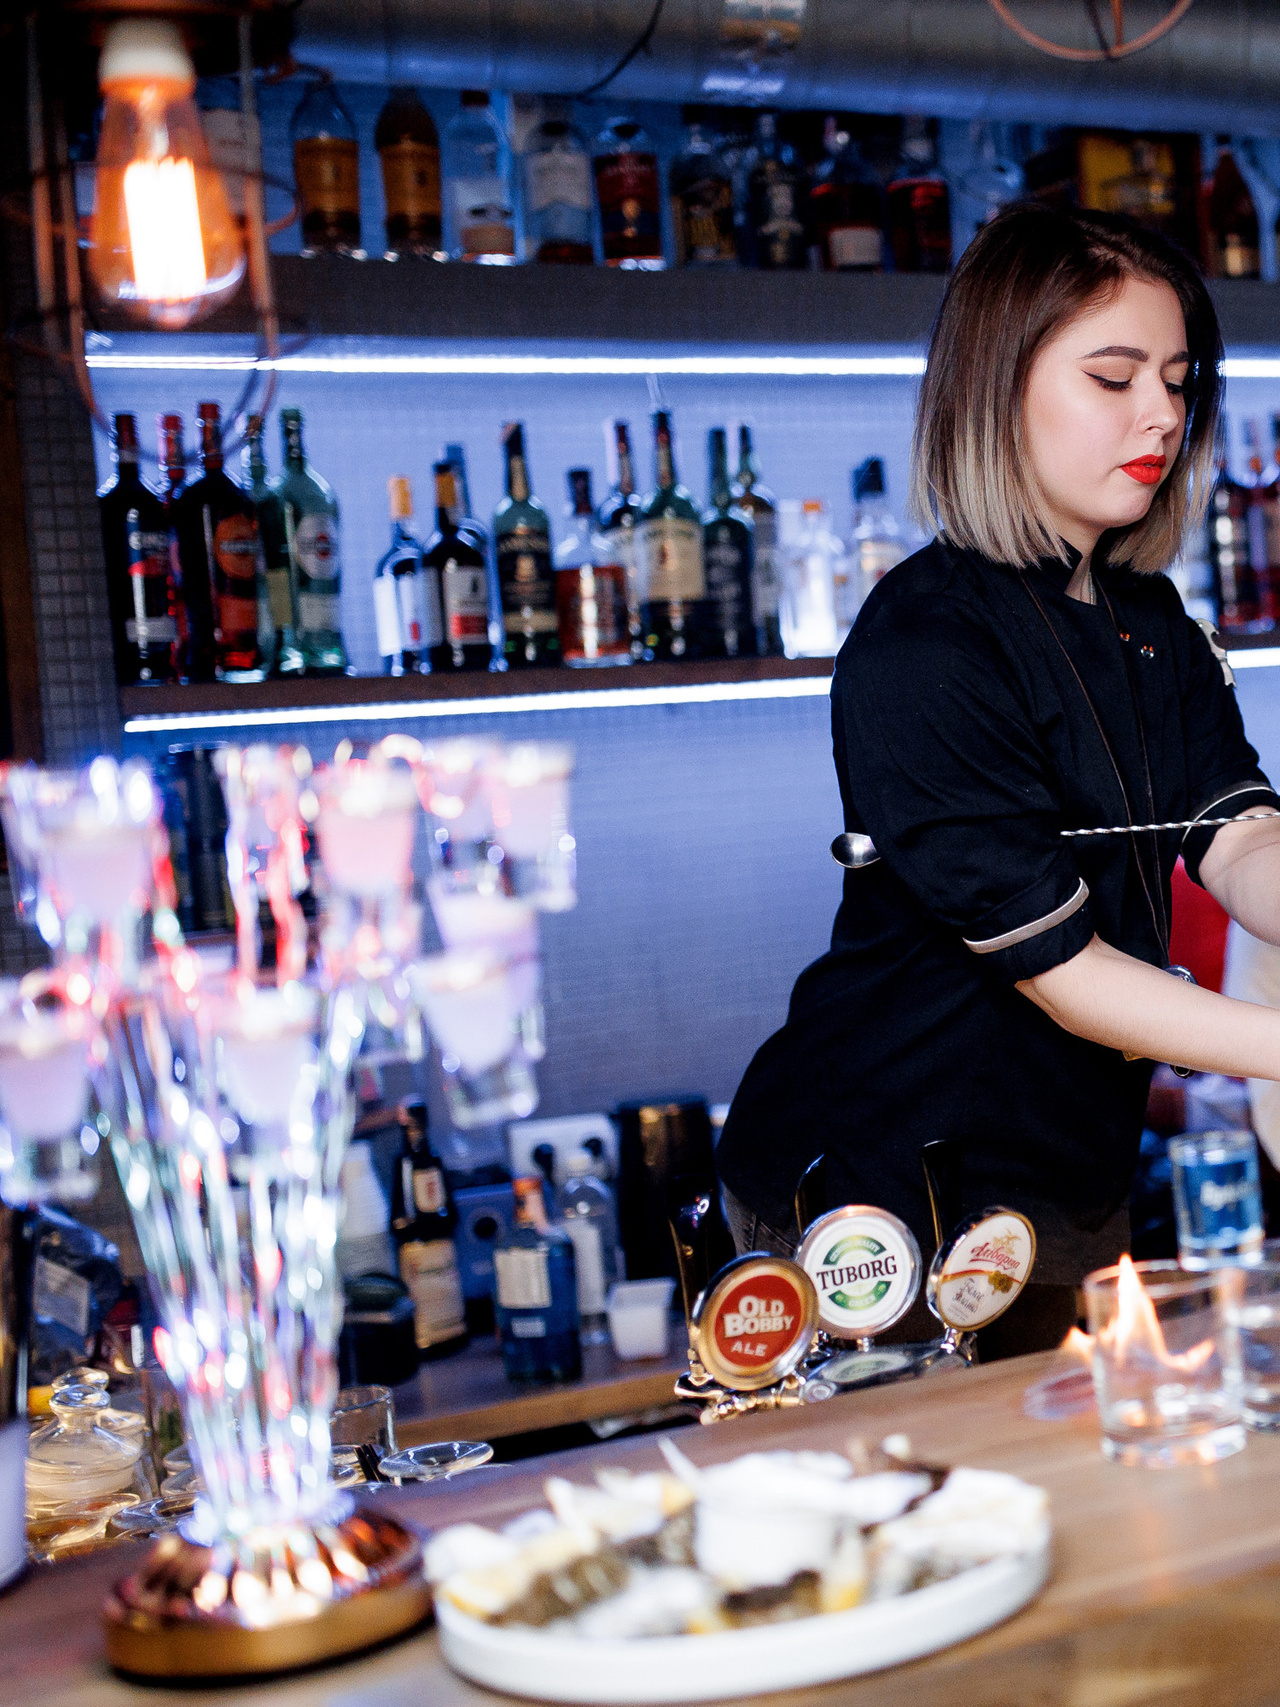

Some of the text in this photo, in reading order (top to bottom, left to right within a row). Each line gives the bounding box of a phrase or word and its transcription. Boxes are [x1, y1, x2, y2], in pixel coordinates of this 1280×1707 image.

[816, 1255, 898, 1291] TUBORG
[738, 1295, 785, 1318] OLD
[724, 1312, 795, 1339] BOBBY
[731, 1340, 768, 1357] ALE
